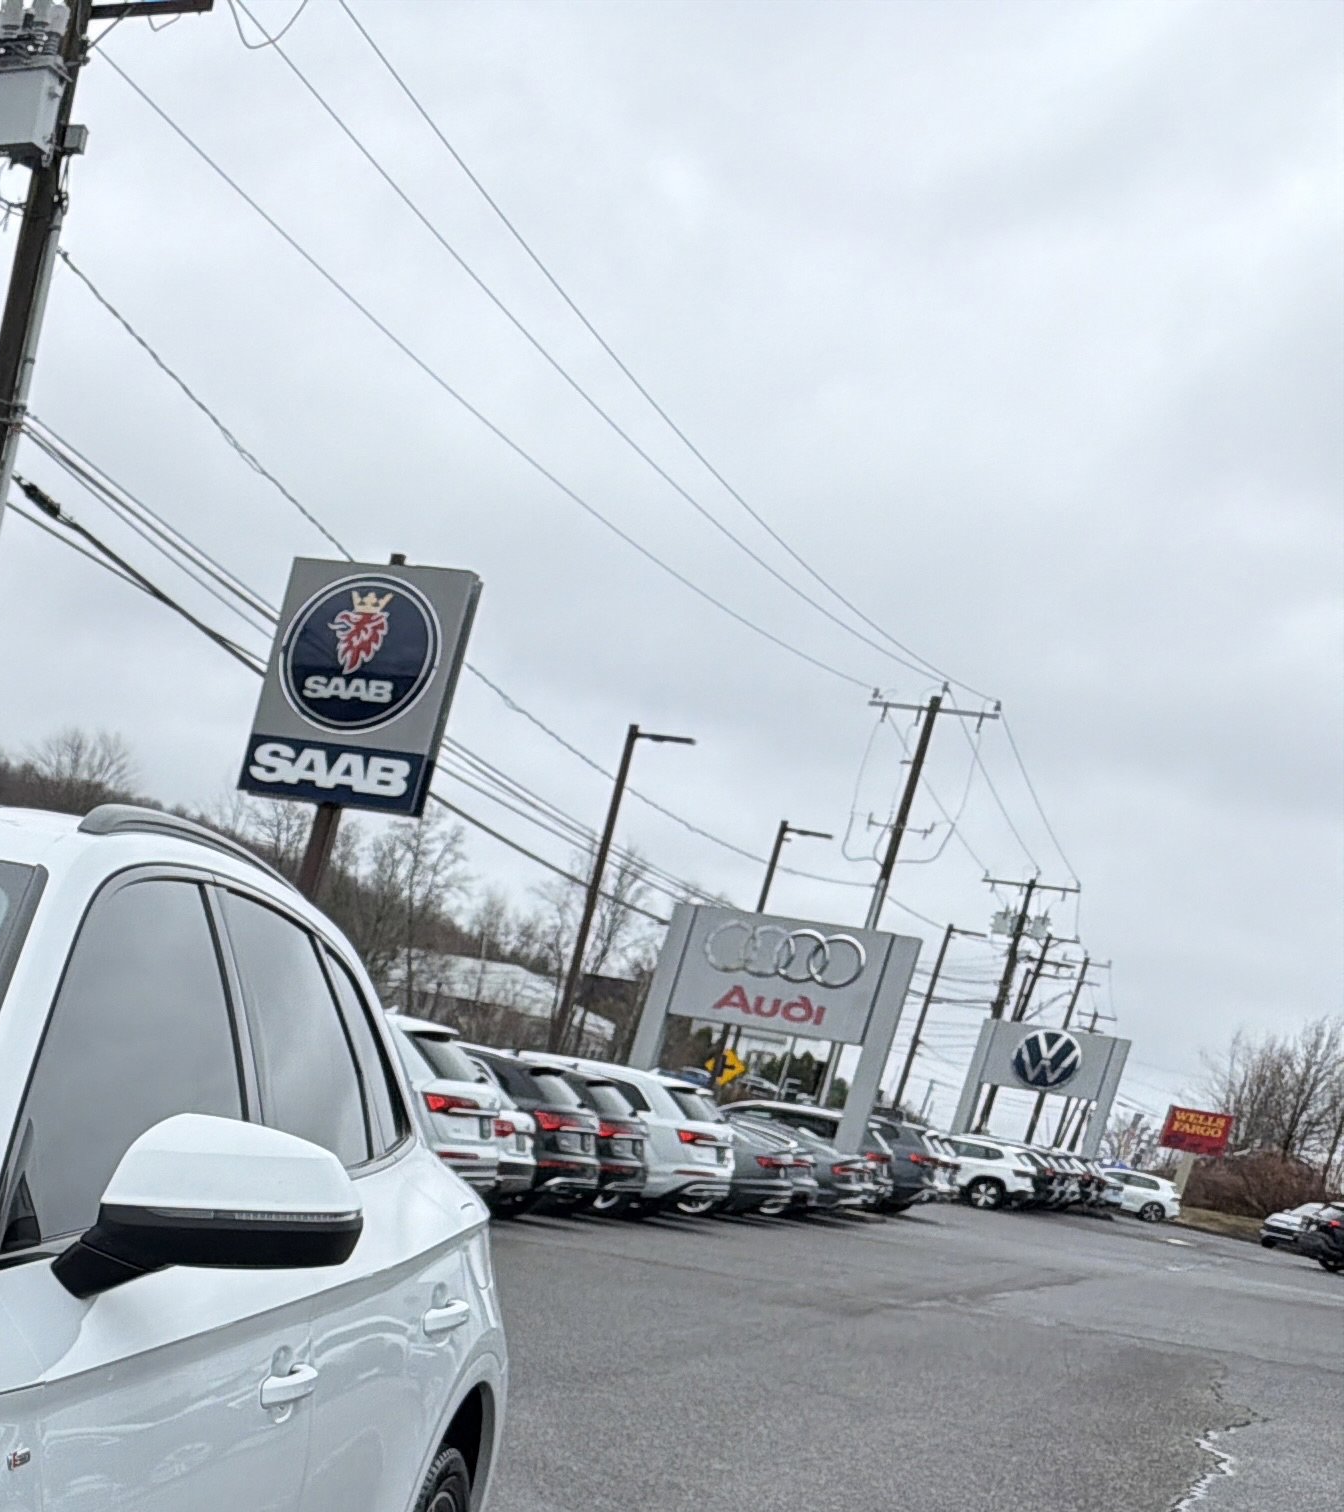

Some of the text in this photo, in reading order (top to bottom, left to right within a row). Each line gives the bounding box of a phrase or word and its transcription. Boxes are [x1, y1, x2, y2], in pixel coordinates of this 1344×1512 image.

[302, 675, 394, 704] SAAB
[249, 743, 411, 797] SAAB
[713, 984, 827, 1026] Audi
[1172, 1120, 1222, 1138] FARGO
[1175, 1110, 1226, 1128] WELLS
